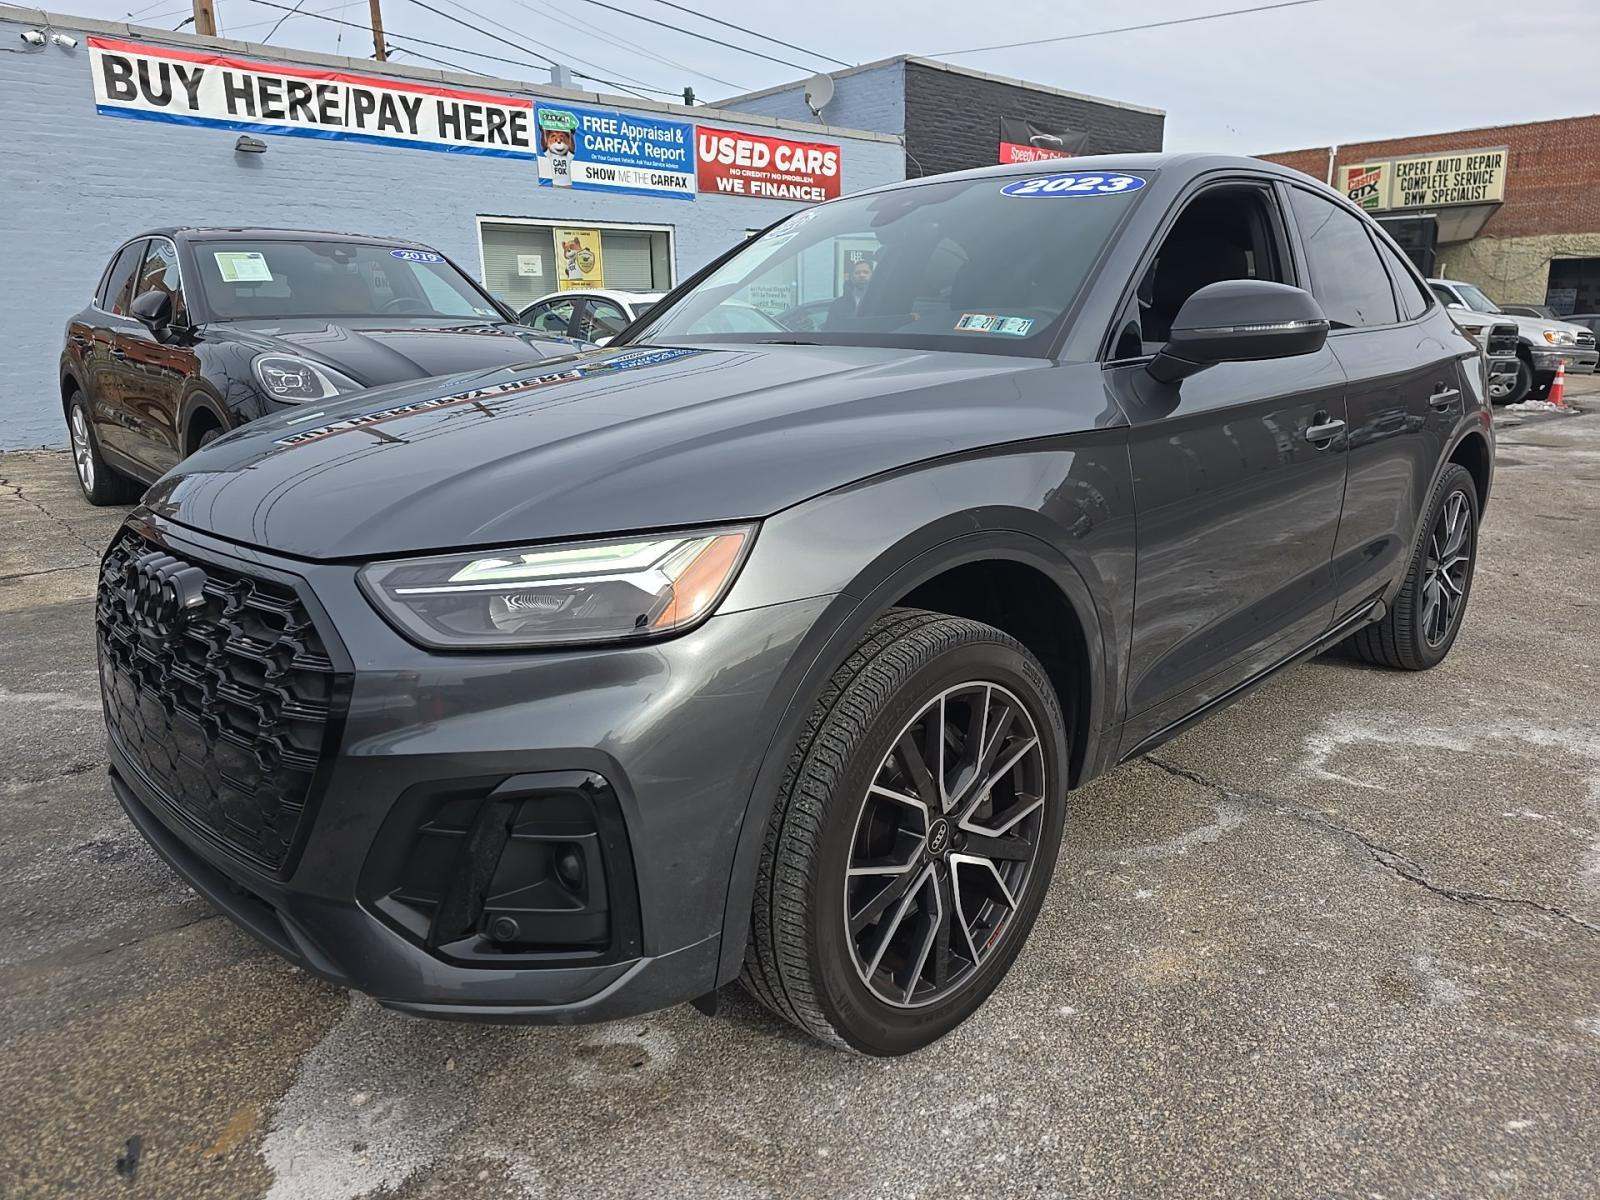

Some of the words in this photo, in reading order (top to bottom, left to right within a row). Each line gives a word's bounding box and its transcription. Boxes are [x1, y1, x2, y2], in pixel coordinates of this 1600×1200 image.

[101, 54, 204, 111] BUY
[224, 72, 422, 135] HERE/PAY
[437, 101, 530, 147] HERE
[583, 116, 617, 135] FREE
[620, 121, 674, 141] Appraisal
[675, 128, 684, 143] &
[584, 135, 640, 156] CARFAX
[645, 142, 685, 161] Report
[699, 134, 770, 168] USED
[775, 145, 837, 177] CARS
[1010, 145, 1035, 163] Speedy
[553, 159, 567, 168] CAR
[554, 168, 567, 176] FOX
[1396, 161, 1432, 178] EXPERT
[1436, 158, 1461, 174] AUTO
[1466, 154, 1502, 171] REPAIR
[585, 167, 616, 182] SHOW
[618, 168, 633, 183] ME
[634, 170, 649, 185] THE
[650, 173, 688, 188] CARFAX
[729, 168, 741, 176] NO
[741, 169, 770, 179] CREDIT?
[771, 172, 781, 180] NO
[782, 174, 814, 183] PROBLEM
[1011, 177, 1133, 194] 2023
[1400, 174, 1448, 191] COMPLETE
[1454, 170, 1495, 187] SERVICE
[716, 177, 744, 194] WE
[751, 180, 826, 201] FINANCE!
[1348, 180, 1378, 200] GTX
[1404, 190, 1426, 205] BMW
[1431, 185, 1488, 203] SPECIALIST
[401, 250, 436, 261] 2019
